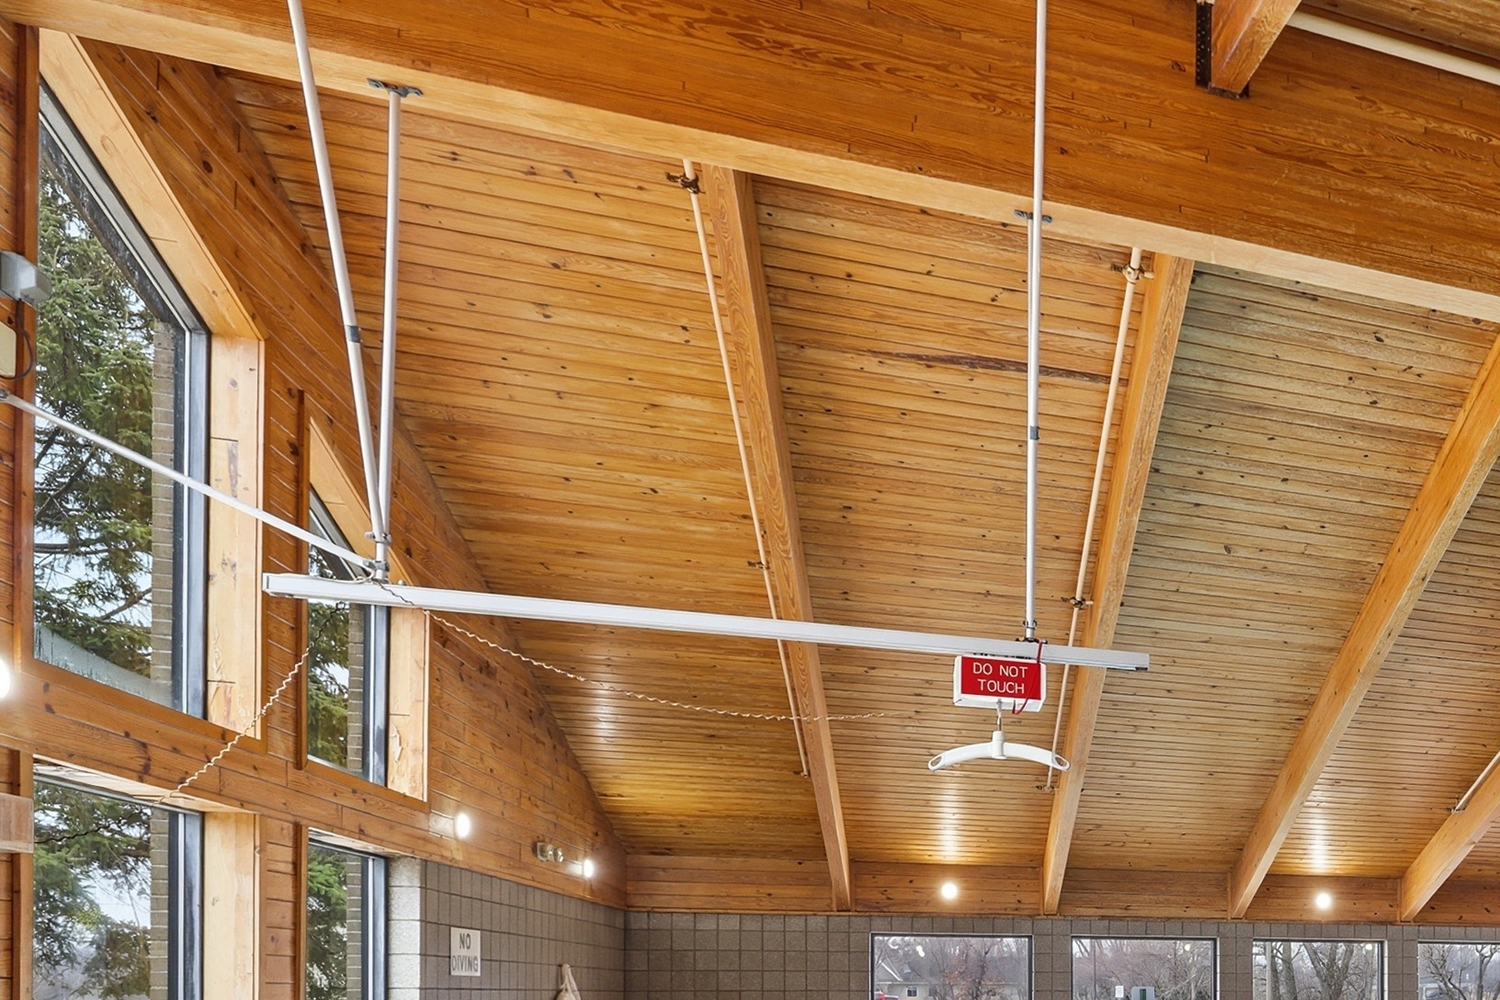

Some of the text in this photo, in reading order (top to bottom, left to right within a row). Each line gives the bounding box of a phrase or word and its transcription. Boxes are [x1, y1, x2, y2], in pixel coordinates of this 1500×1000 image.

[973, 662, 1028, 678] DO NOT
[977, 679, 1024, 694] TOUCH
[459, 933, 471, 950] NO
[451, 955, 479, 972] DIVING
